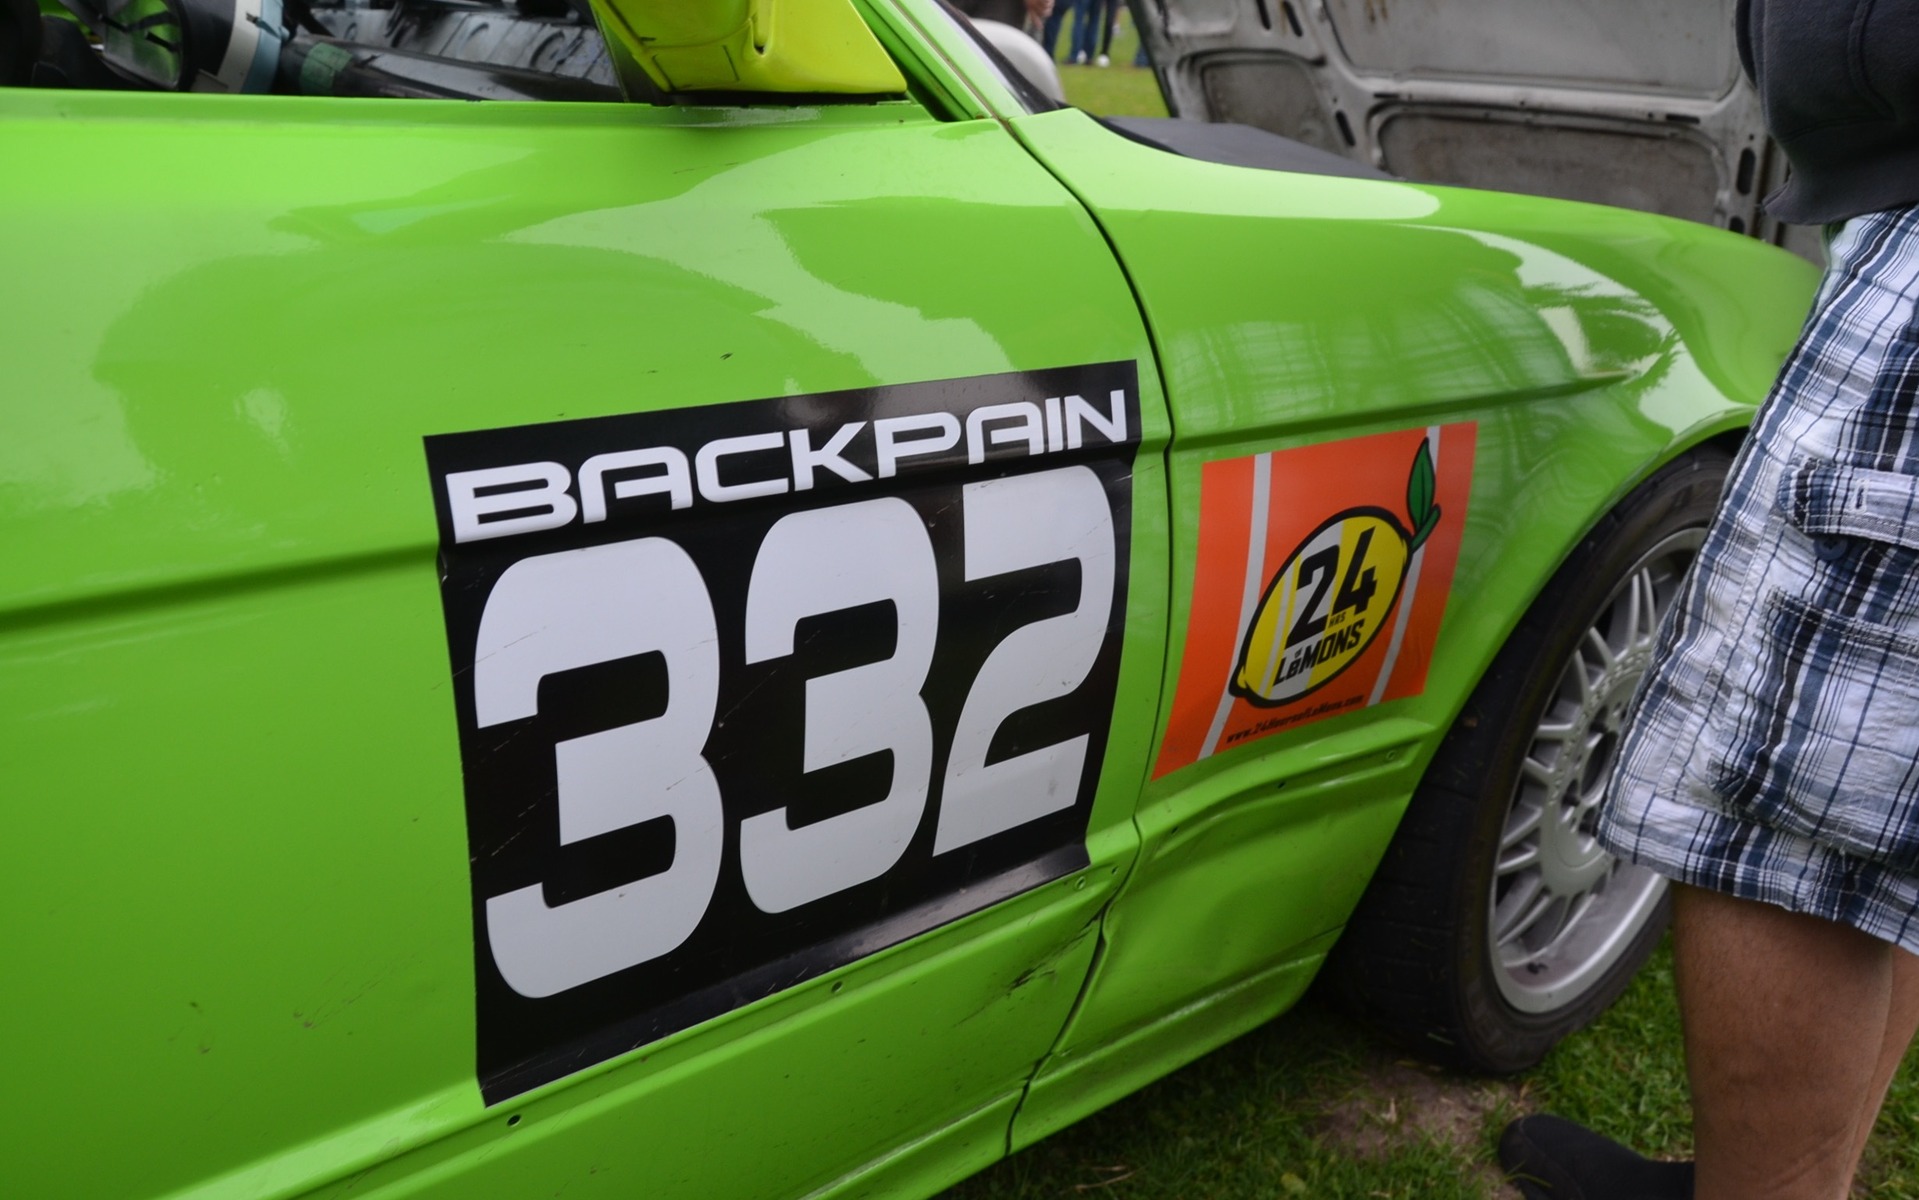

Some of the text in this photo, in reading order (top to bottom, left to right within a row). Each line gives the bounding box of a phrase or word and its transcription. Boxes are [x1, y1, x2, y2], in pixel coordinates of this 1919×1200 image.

[446, 389, 1128, 544] BACKPAIN
[1284, 526, 1378, 650] 24
[474, 464, 1116, 999] 332
